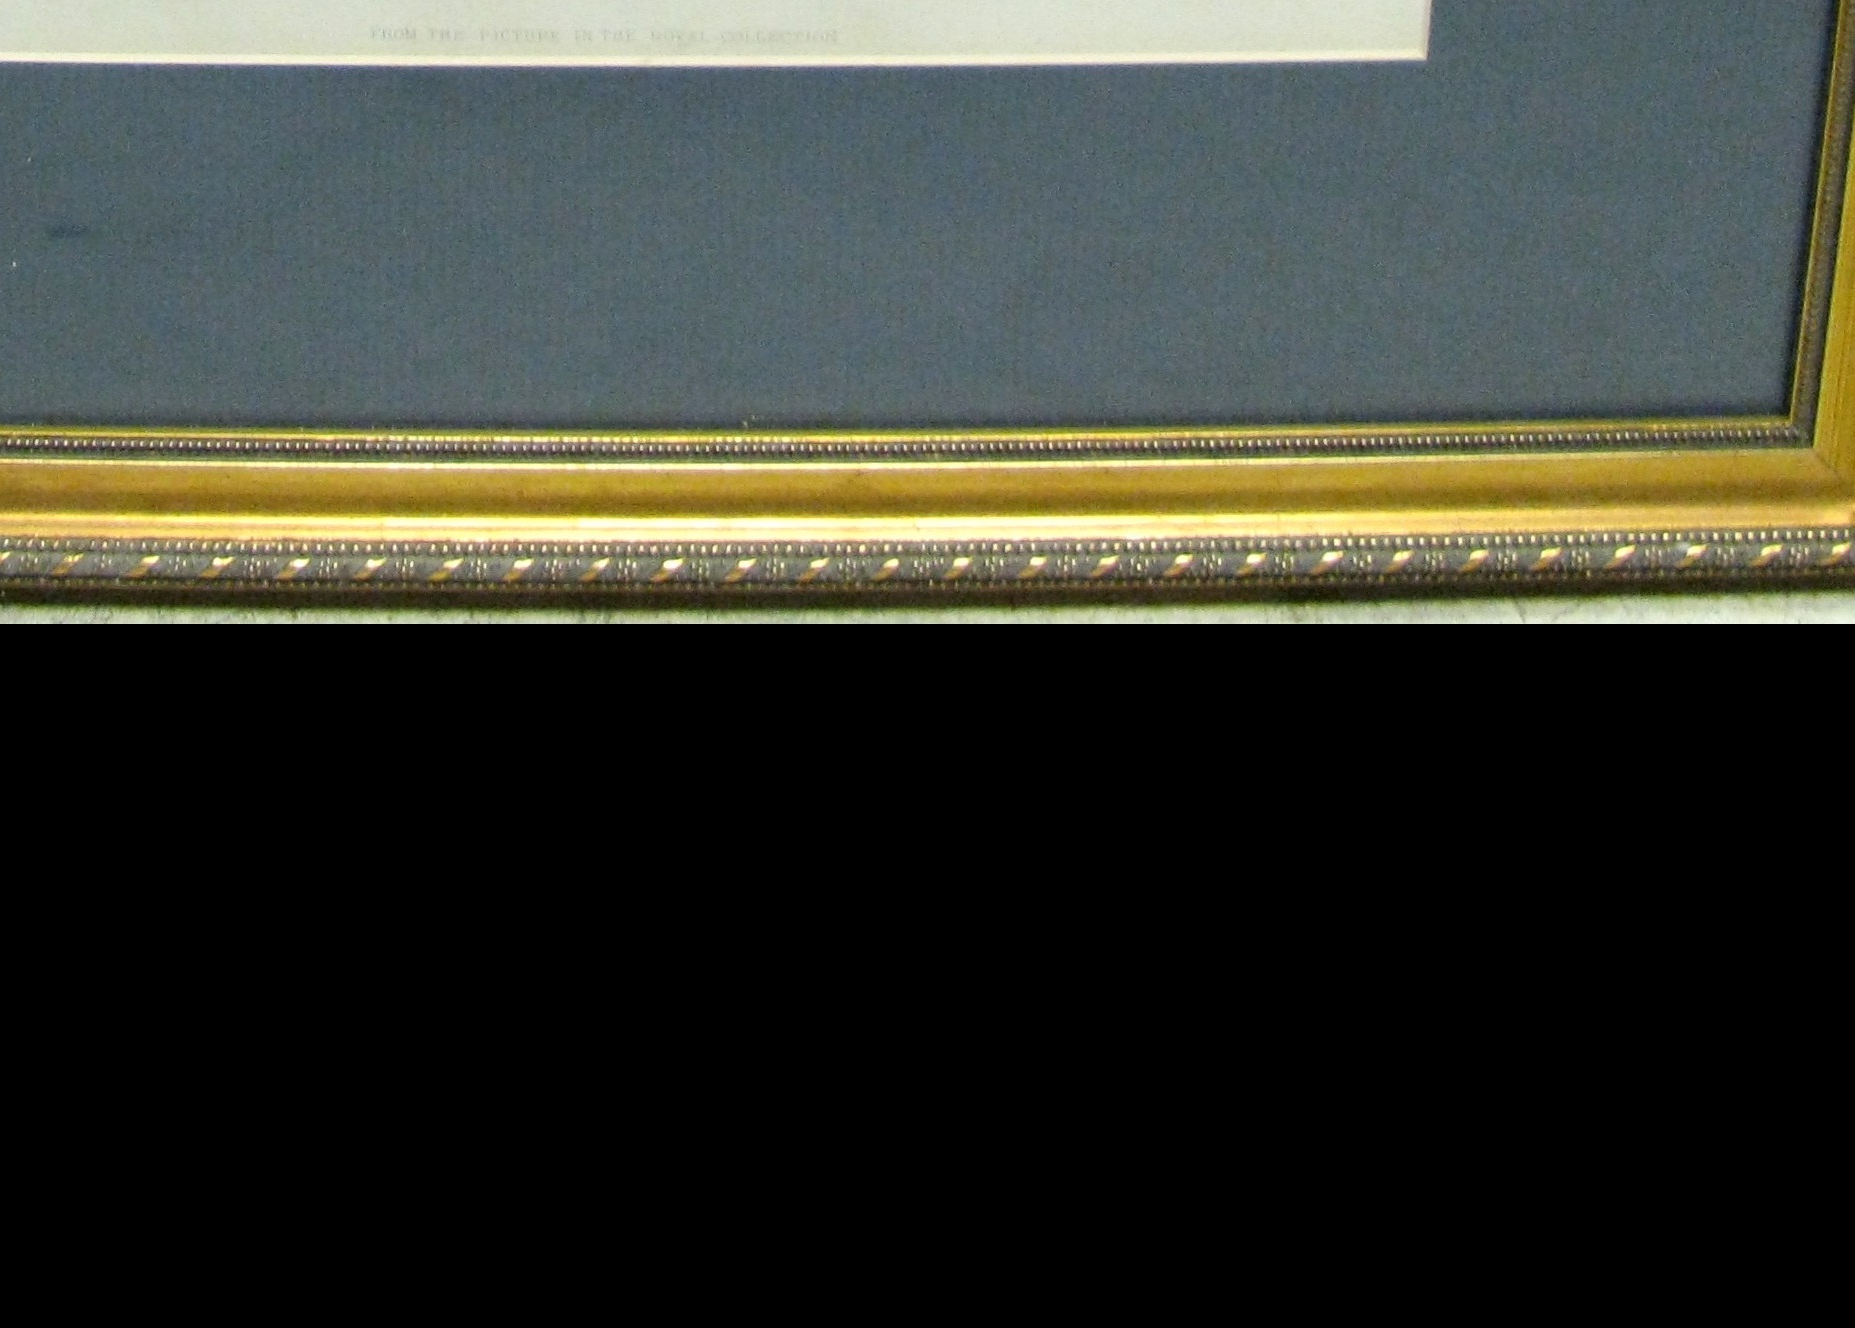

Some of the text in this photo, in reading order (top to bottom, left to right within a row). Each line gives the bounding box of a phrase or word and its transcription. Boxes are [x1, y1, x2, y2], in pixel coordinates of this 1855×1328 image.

[369, 26, 417, 41] FROM
[429, 27, 464, 42] THE
[479, 28, 560, 43] PICTURE
